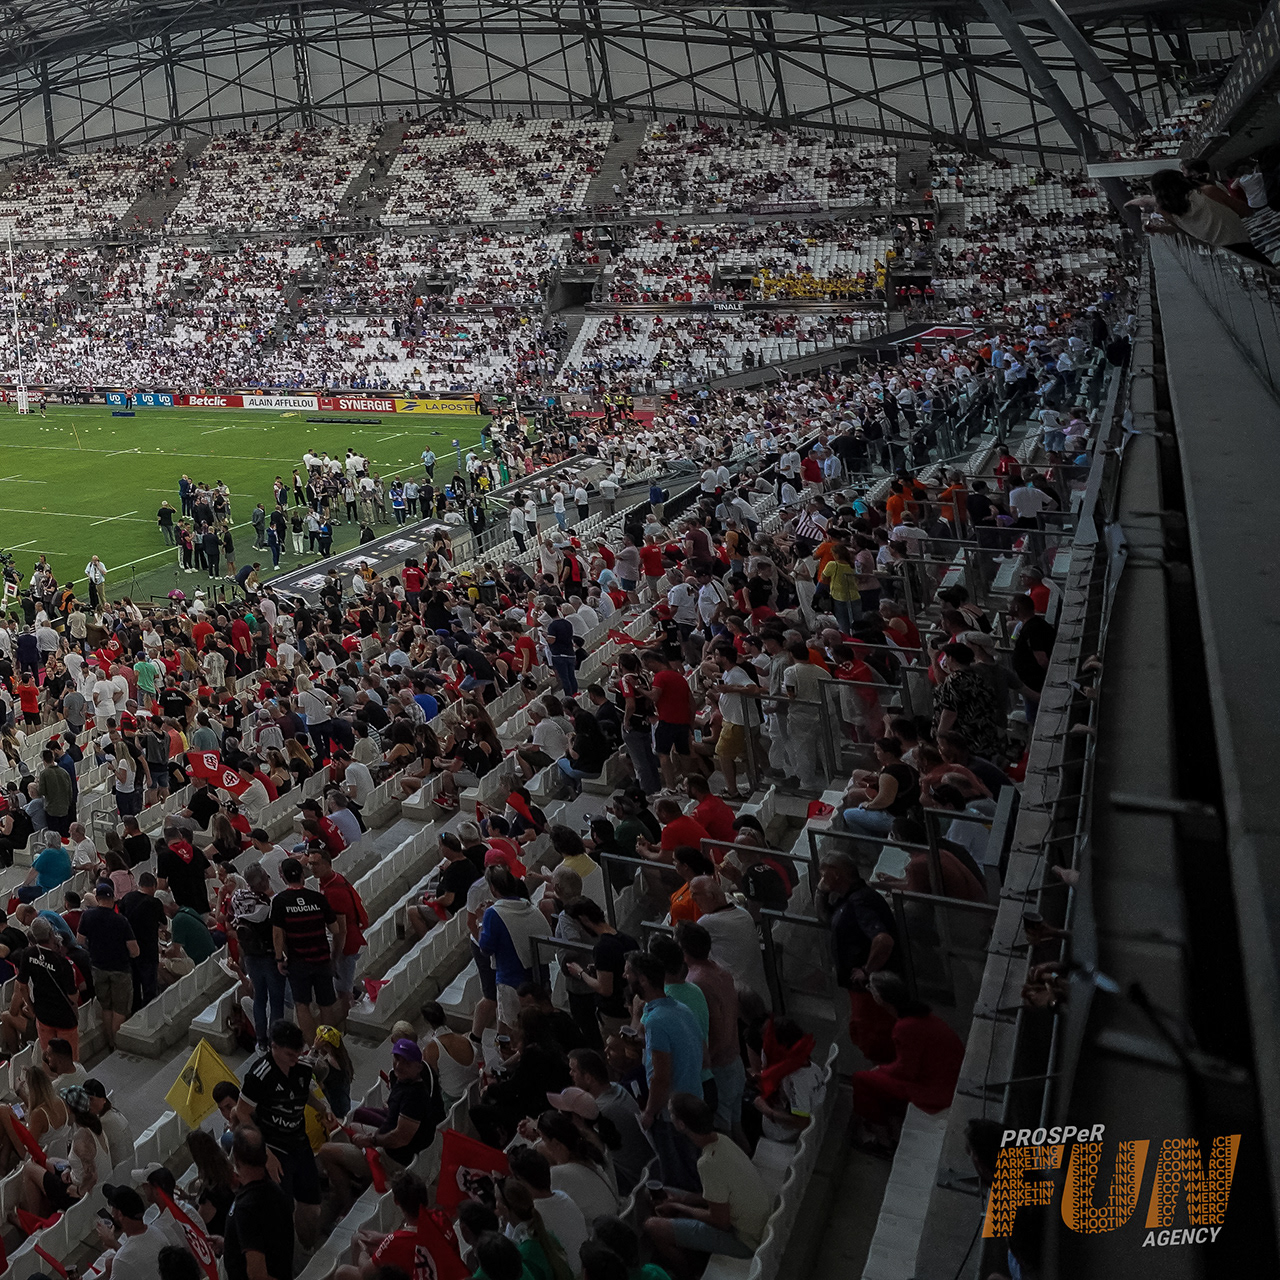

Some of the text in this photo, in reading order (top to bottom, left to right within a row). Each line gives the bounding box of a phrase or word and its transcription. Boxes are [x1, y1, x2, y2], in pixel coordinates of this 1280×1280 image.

[713, 303, 744, 311] FINALE
[189, 396, 227, 406] Betclic
[248, 398, 314, 408] ALAIN AFFLELOU
[339, 400, 393, 411] SYNERGIE
[286, 905, 321, 913] FIDUCIAL
[29, 957, 56, 972] FIDUCIAL
